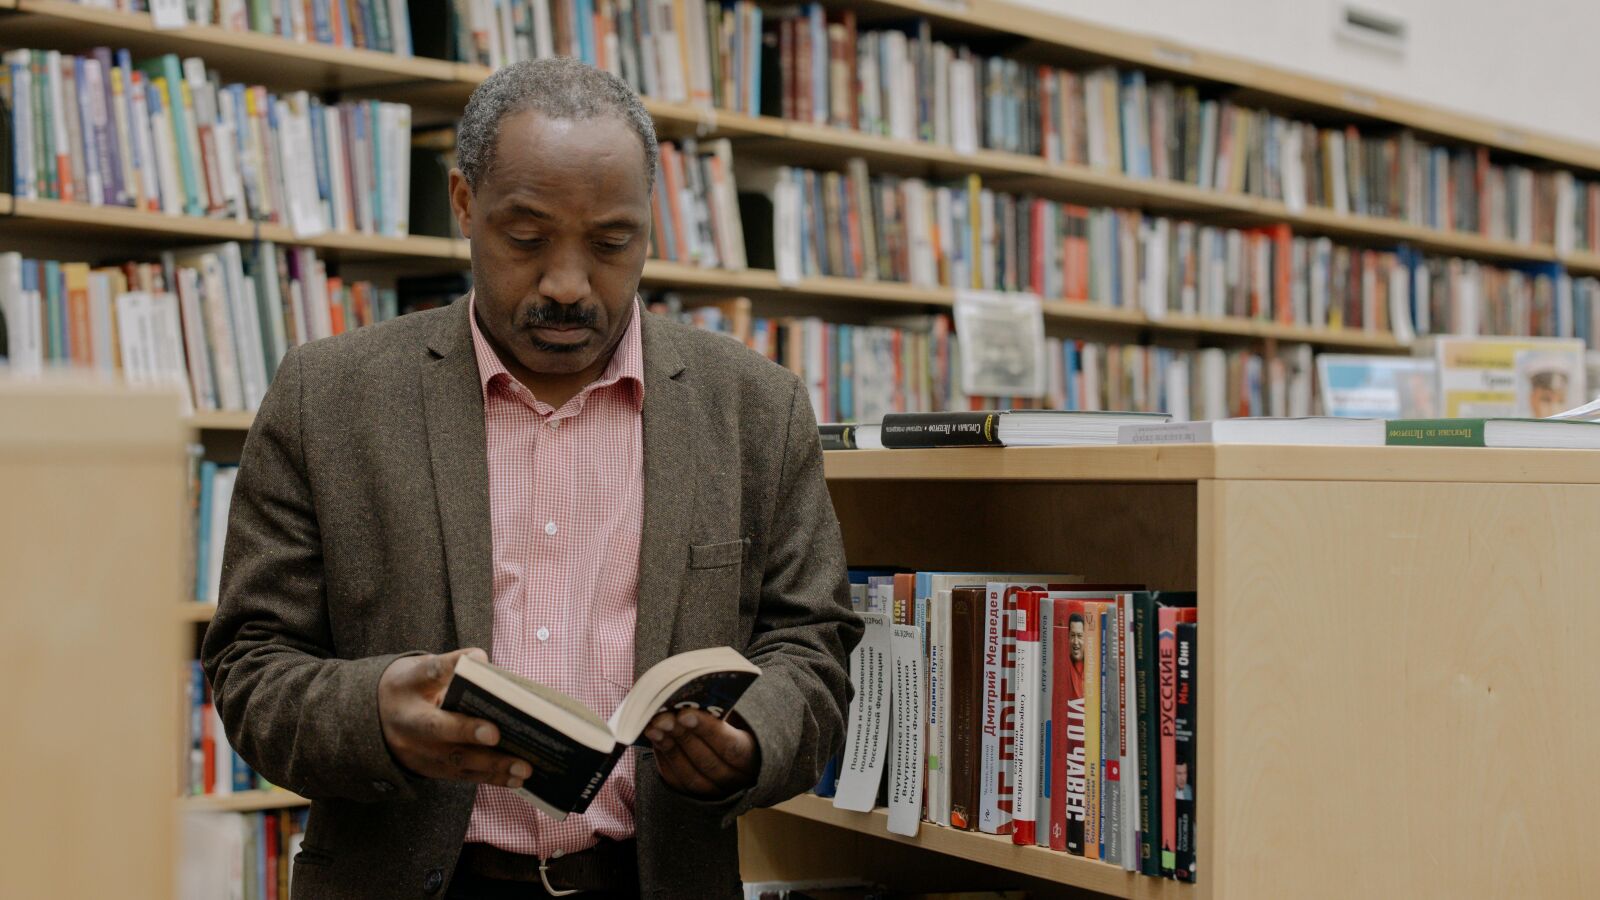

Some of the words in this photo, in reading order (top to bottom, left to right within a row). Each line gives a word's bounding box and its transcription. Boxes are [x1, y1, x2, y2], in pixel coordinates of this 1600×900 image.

[893, 600, 901, 624] ТОК
[985, 591, 998, 665] Медведев
[866, 646, 875, 703] положение
[874, 652, 884, 710] Федерации
[930, 645, 938, 673] Путин
[1178, 641, 1190, 666] Они
[1181, 669, 1189, 679] и
[851, 723, 863, 771] Политика
[857, 647, 866, 712] современное
[895, 655, 904, 728] положение.
[903, 665, 911, 721] политика
[910, 660, 920, 731] Федерации
[930, 676, 938, 724] Владимир
[984, 670, 997, 737] Дмитрий
[1066, 697, 1086, 741] УГО
[1161, 648, 1173, 737] РУССКИЕ
[1178, 682, 1189, 704] Мы
[860, 705, 873, 773] политическое
[869, 711, 882, 769] Российской
[1018, 693, 1026, 757] Современная
[893, 731, 904, 803] Внутреннее
[902, 725, 911, 797] Внутренняя
[908, 734, 919, 804] Российской
[1017, 758, 1025, 813] российская
[1066, 746, 1086, 822] ЧАВЕС
